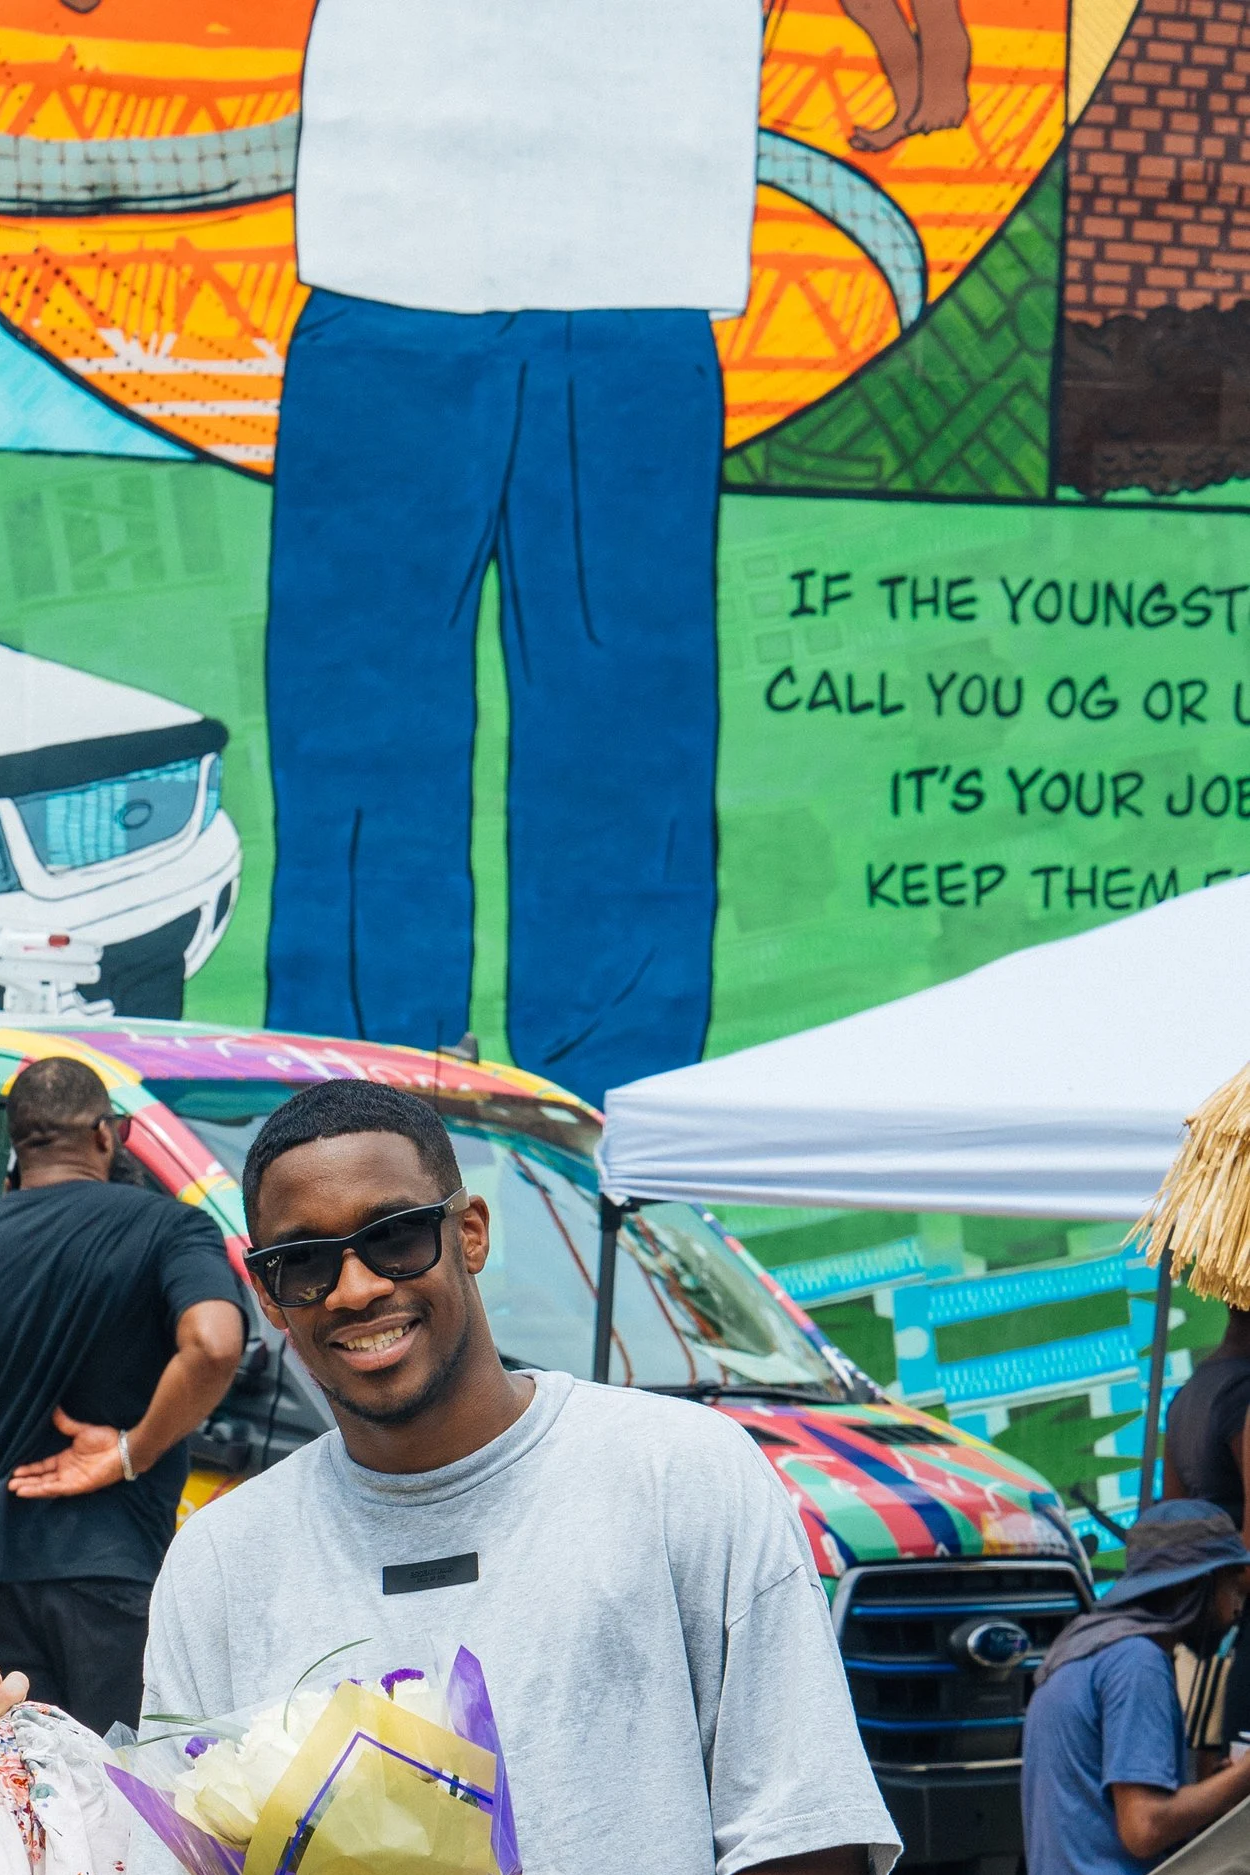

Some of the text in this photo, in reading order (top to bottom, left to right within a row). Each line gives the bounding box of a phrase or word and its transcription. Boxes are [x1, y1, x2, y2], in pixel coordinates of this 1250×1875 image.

[789, 568, 1250, 634] IF THE YOUNGST
[765, 666, 906, 717] CALL
[926, 671, 1024, 718] YOU
[1046, 674, 1120, 721] OG
[1142, 679, 1209, 726] OR
[891, 765, 986, 818] IT'S
[1006, 767, 1145, 818] YOUR
[866, 862, 1007, 910] KEEP
[1030, 865, 1180, 910] THEM
